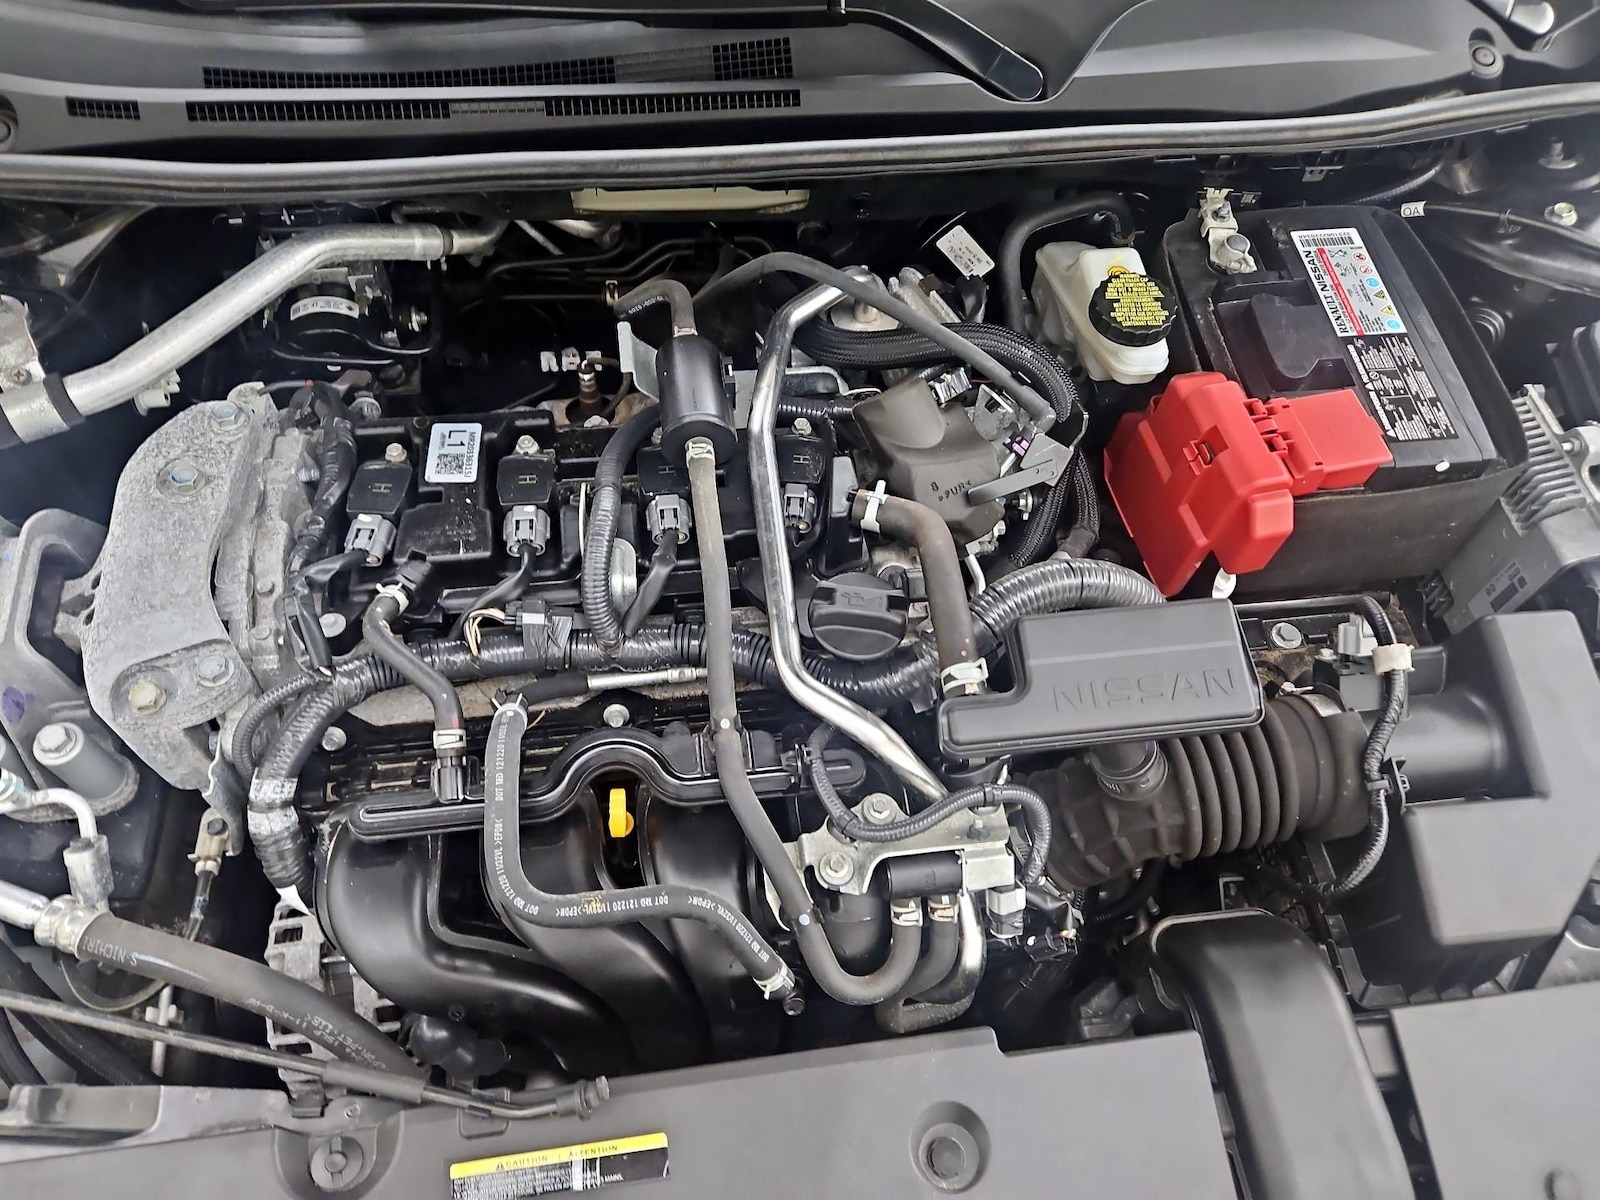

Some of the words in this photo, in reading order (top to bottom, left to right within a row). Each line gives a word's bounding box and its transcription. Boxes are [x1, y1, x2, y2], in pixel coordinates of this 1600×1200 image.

[1302, 250, 1330, 292] NISSAN
[1324, 294, 1350, 334] RENAULT
[447, 430, 467, 446] L1
[1052, 668, 1234, 712] NISSAN
